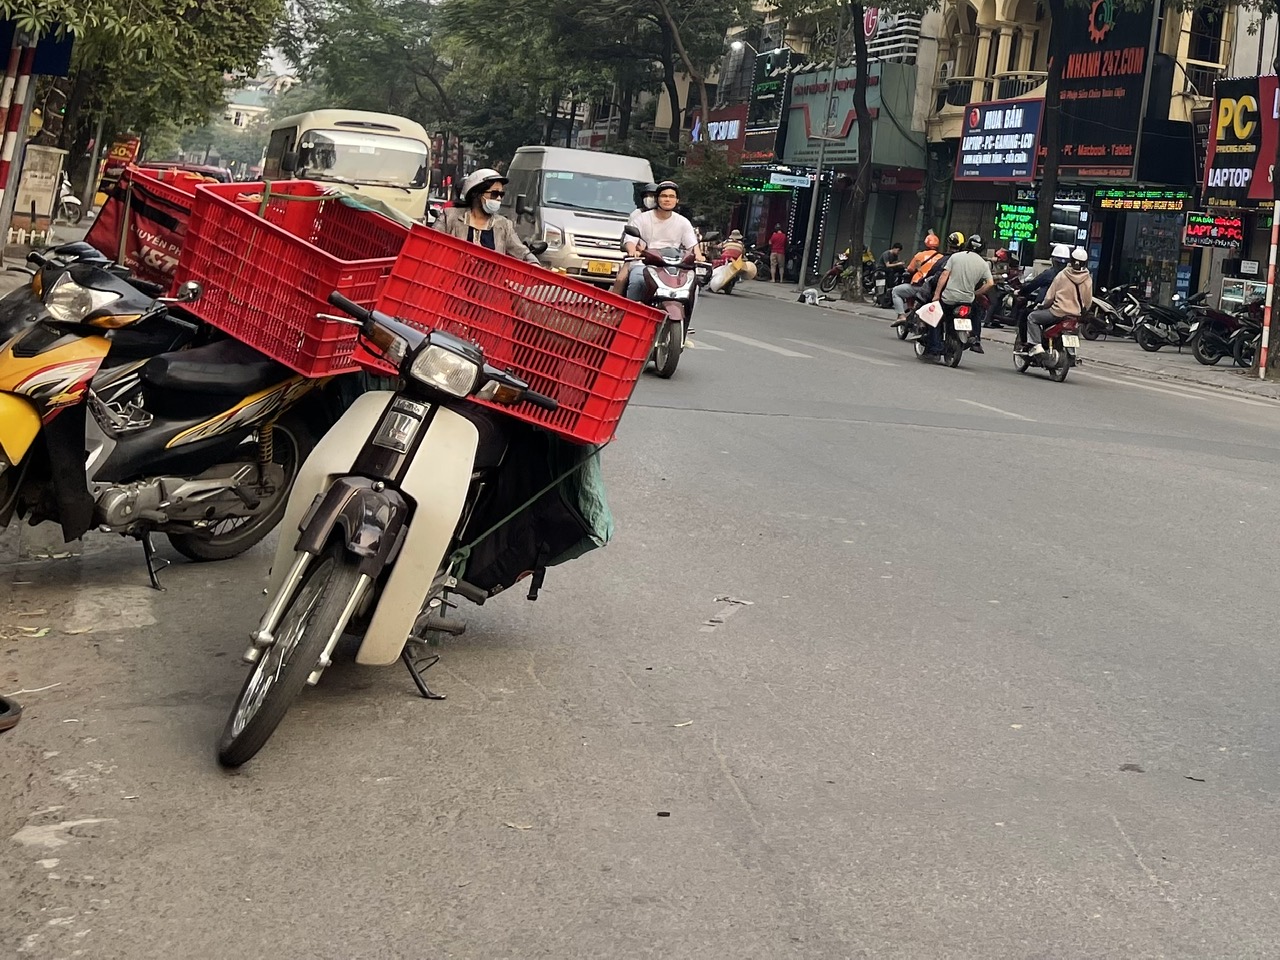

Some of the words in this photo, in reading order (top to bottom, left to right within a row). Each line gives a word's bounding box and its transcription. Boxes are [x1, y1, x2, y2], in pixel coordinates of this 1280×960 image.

[1066, 51, 1101, 79] NHANH
[1101, 47, 1145, 77] 247.COM
[984, 110, 1004, 130] MUA
[1004, 105, 1024, 129] BÁN
[1216, 95, 1258, 141] PC
[1208, 168, 1252, 188] LAPTOP
[1000, 204, 1017, 212] THU
